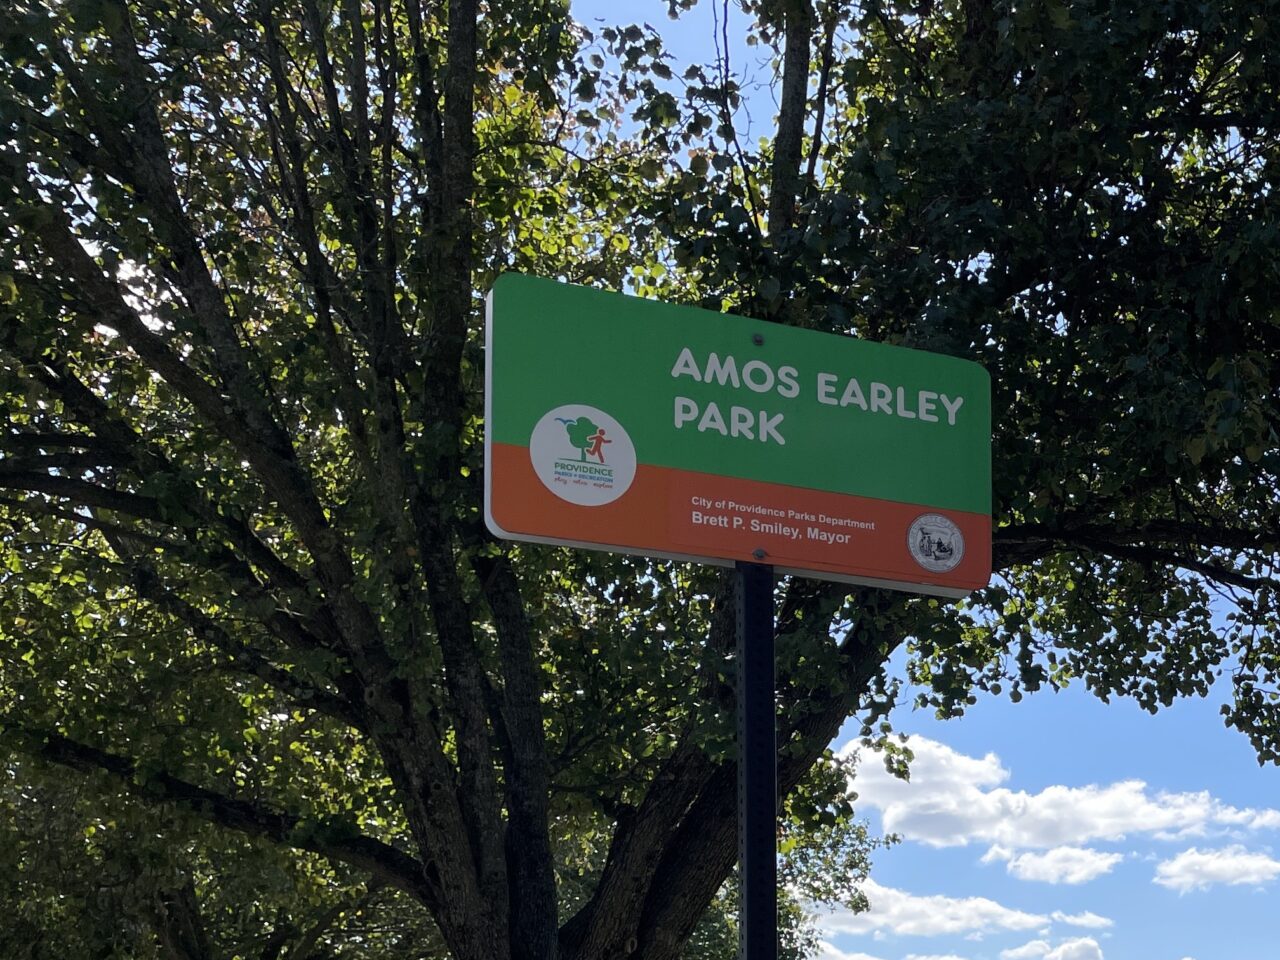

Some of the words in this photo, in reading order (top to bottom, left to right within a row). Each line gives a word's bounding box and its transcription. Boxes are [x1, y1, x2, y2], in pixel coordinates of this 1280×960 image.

[671, 347, 799, 398] AMOS
[817, 372, 964, 425] EARLEY
[674, 396, 785, 445] PARK
[554, 462, 614, 477] PROVIDENCE
[692, 496, 712, 509] City
[715, 500, 726, 509] of
[728, 502, 785, 518] Providence
[788, 510, 816, 522] Parks
[819, 514, 875, 531] Department
[692, 511, 728, 528] Brett
[733, 516, 746, 530] P.
[750, 519, 803, 540] Smiley,
[807, 527, 851, 545] Mayor
